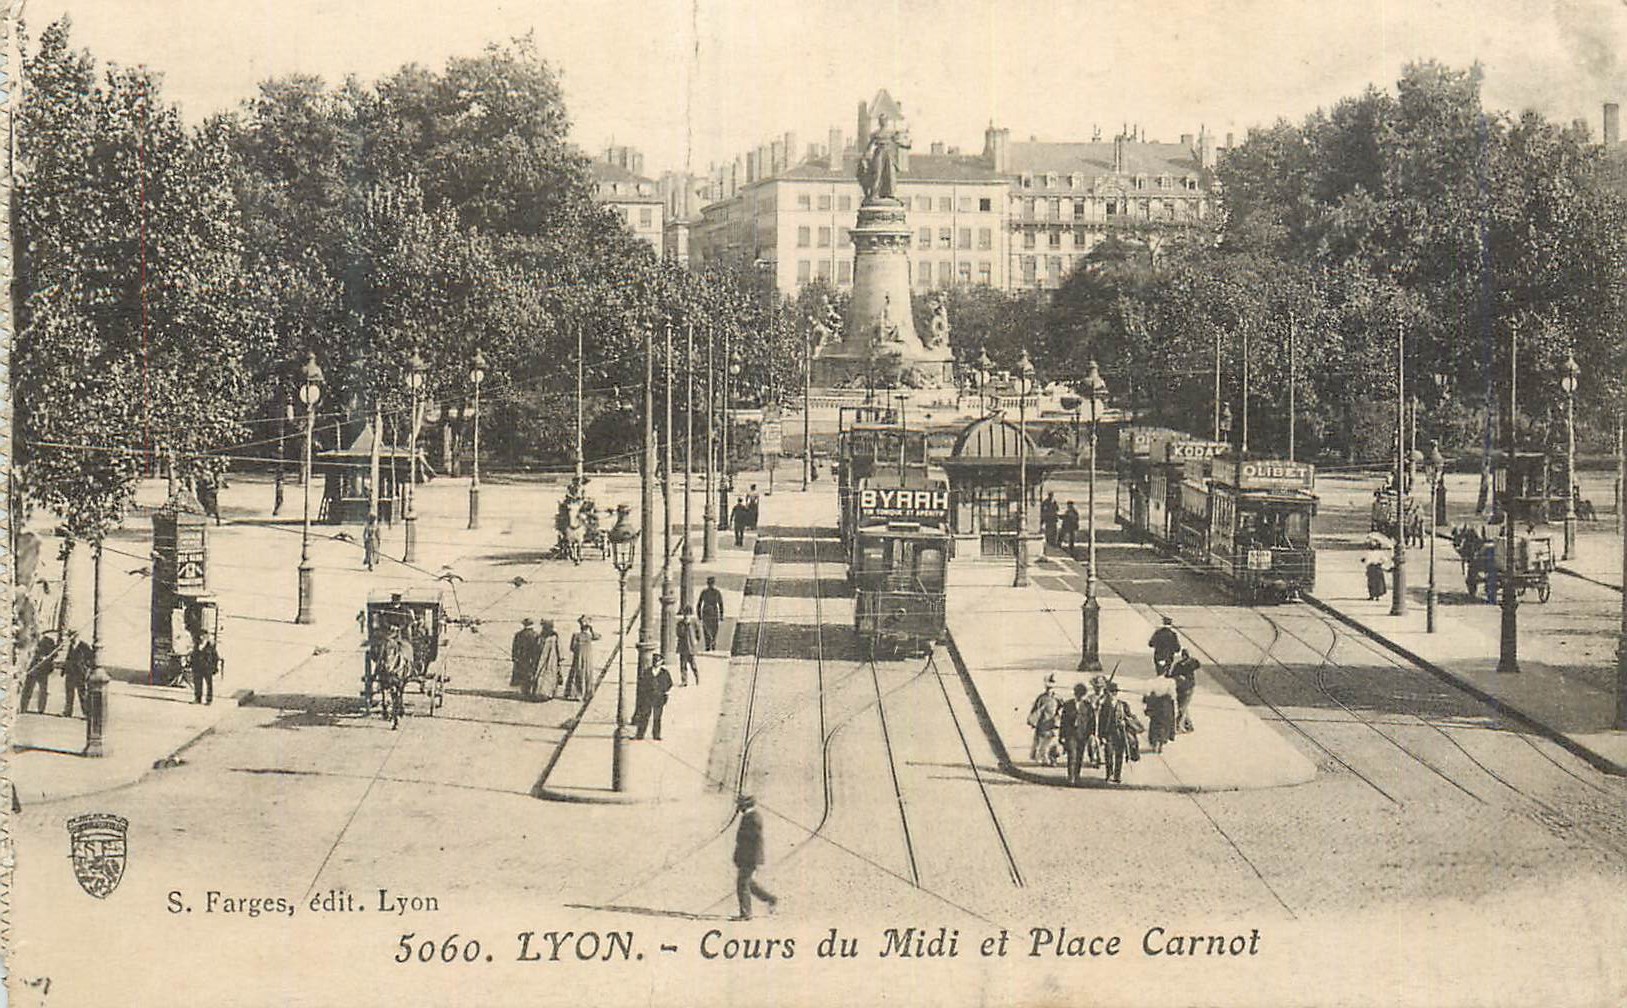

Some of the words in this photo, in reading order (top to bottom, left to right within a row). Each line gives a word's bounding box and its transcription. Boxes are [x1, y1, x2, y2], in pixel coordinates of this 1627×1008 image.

[1174, 445, 1225, 457] KODAK
[1243, 465, 1308, 478] OLIBET
[861, 490, 949, 510] BYRRH
